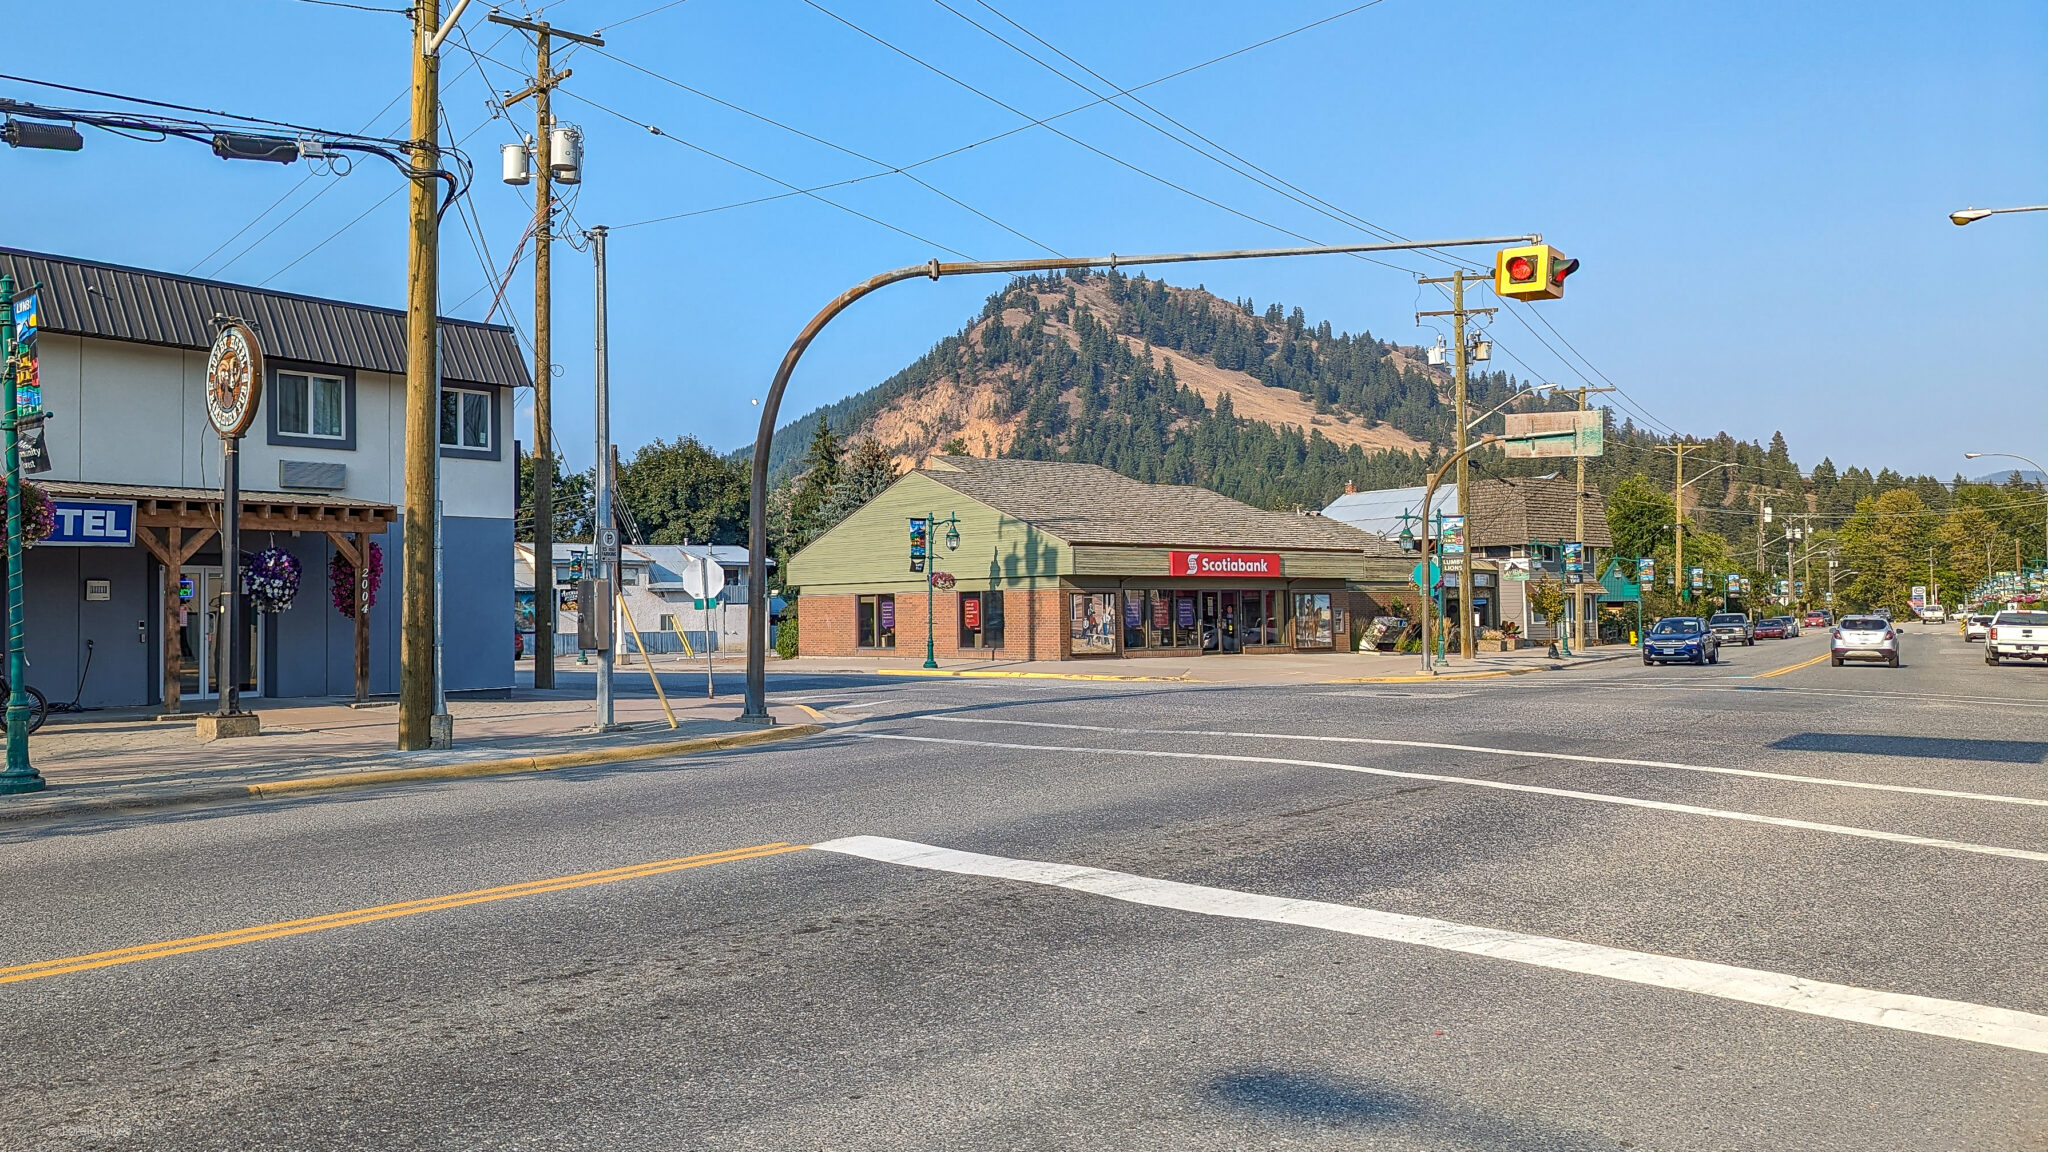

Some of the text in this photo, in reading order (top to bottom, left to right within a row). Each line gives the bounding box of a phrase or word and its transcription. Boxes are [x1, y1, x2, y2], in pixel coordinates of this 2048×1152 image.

[55, 508, 127, 538] TEL
[1201, 557, 1268, 572] Scotiabank
[361, 568, 369, 614] 2004
